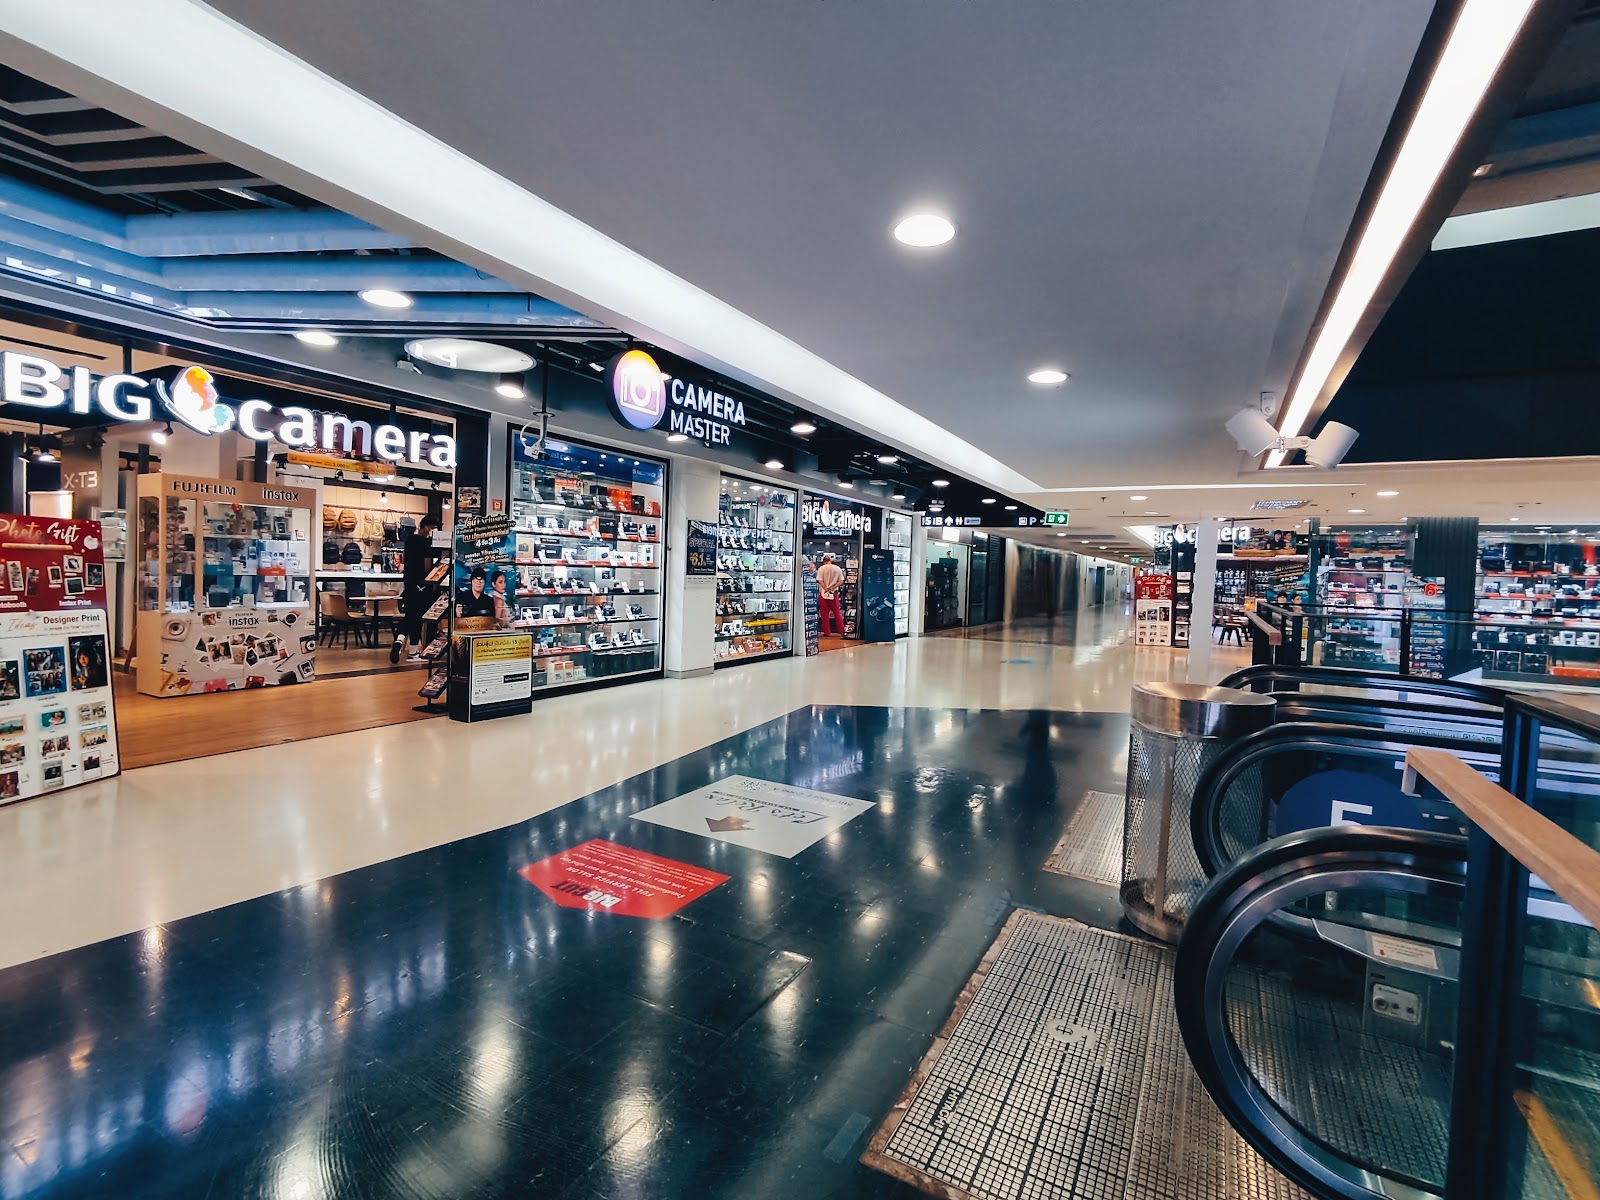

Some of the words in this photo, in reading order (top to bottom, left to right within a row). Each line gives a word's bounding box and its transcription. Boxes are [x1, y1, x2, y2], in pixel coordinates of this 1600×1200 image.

[4, 350, 151, 422] BIG
[238, 399, 457, 468] camera
[671, 378, 746, 426] CAMERA
[670, 409, 731, 446] MASTER
[172, 480, 237, 496] FUJIFILM
[262, 487, 300, 502] instax
[802, 504, 820, 524] BIG
[831, 509, 872, 533] camera
[1029, 516, 1037, 525] P
[46, 521, 82, 545] Gift
[1154, 530, 1173, 544] BIG
[43, 616, 79, 625] Designer
[81, 614, 100, 622] Print
[229, 616, 260, 627] instax
[704, 793, 765, 813] Relax
[771, 808, 827, 825] Let's
[565, 866, 593, 880] SALON
[592, 875, 629, 891] SERVICE
[630, 886, 655, 898] FULL
[933, 1089, 960, 1129] HITACHI
